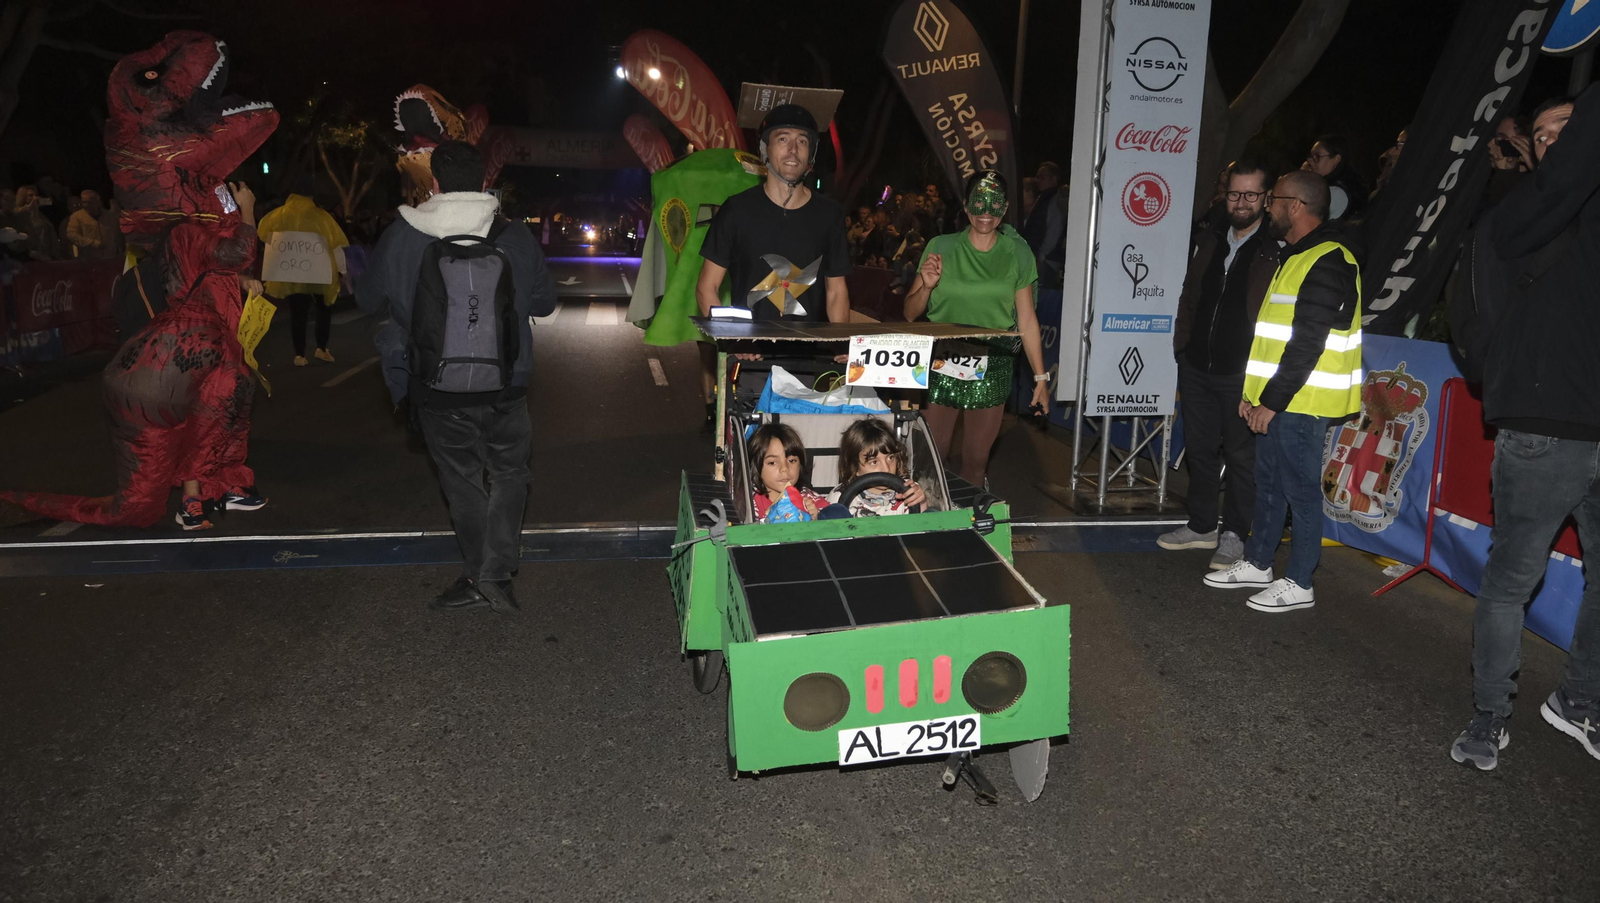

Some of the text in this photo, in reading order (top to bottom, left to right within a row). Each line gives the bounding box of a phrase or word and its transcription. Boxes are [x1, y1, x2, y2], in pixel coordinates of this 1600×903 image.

[1151, 0, 1195, 11] AUTOMOCION
[1126, 58, 1188, 71] NISSAN
[1130, 94, 1183, 104] andalmotor.es
[1115, 122, 1193, 154] Coca-Cola
[272, 240, 325, 255] COMPRO
[280, 259, 311, 272] ORO
[1104, 317, 1151, 330] Almericar
[860, 349, 920, 367] 1030
[942, 350, 982, 369] 1027
[1097, 395, 1160, 404] RENAULT
[844, 718, 977, 762] AL 2512
